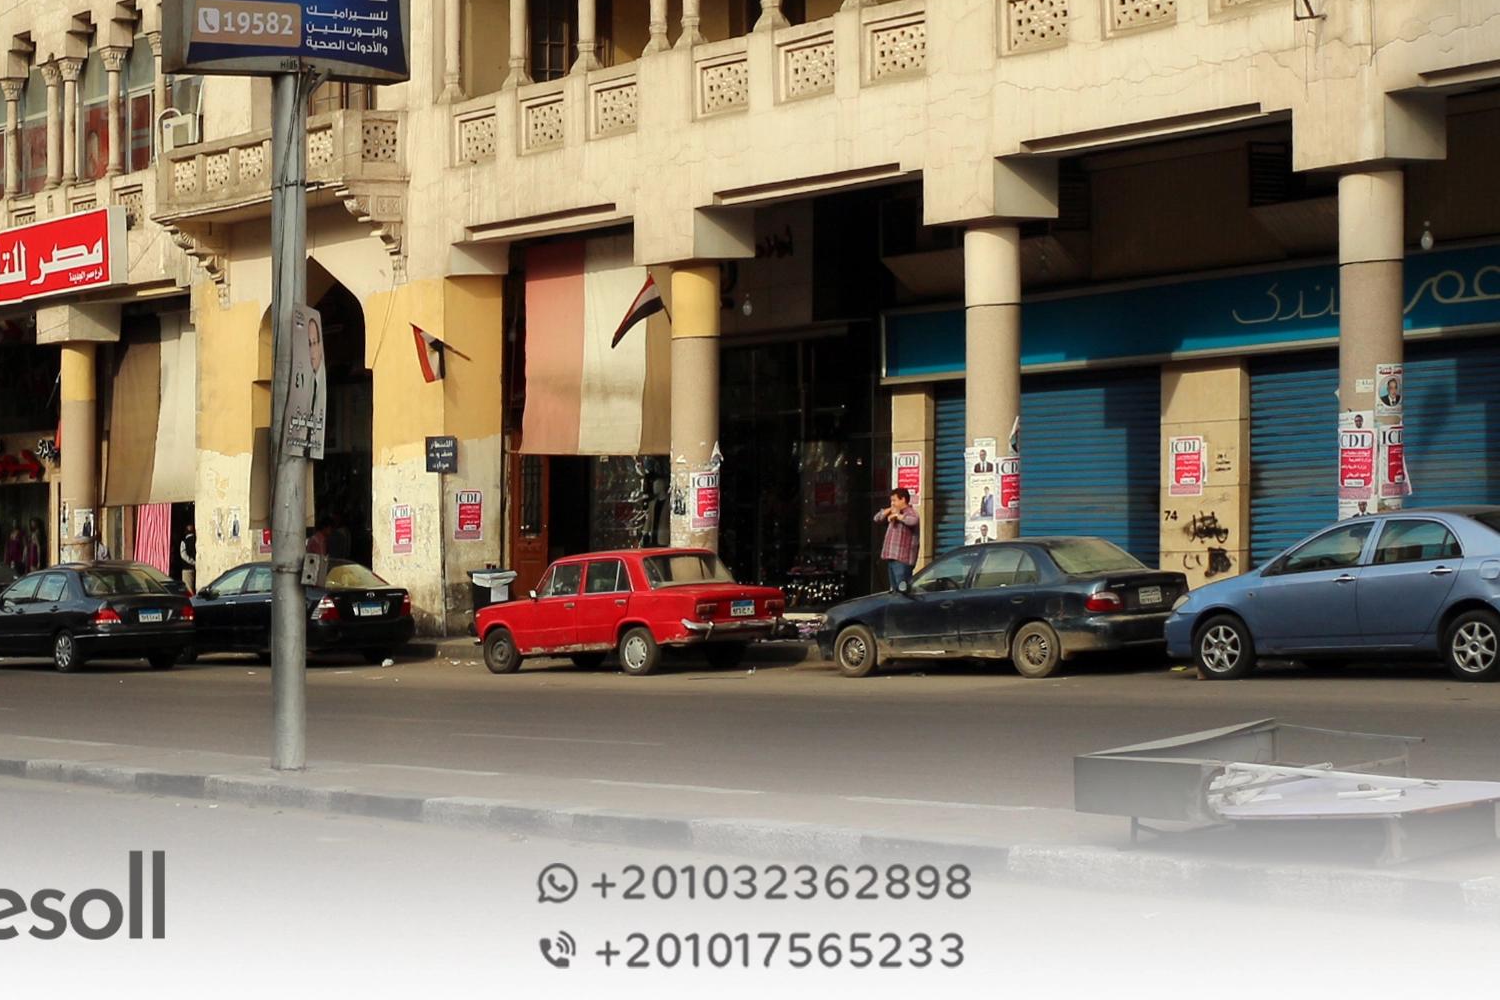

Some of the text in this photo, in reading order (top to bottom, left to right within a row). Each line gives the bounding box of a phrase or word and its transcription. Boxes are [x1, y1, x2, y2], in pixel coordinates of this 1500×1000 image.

[306, 5, 388, 21] للسيراميك
[223, 11, 293, 36] 19582
[306, 21, 388, 39] والبورسلين
[306, 36, 388, 55] والأدوات الصحية
[30, 236, 103, 286] مصر
[1340, 434, 1372, 448] CDL
[995, 461, 1019, 475] ICD
[1164, 510, 1178, 521] 74
